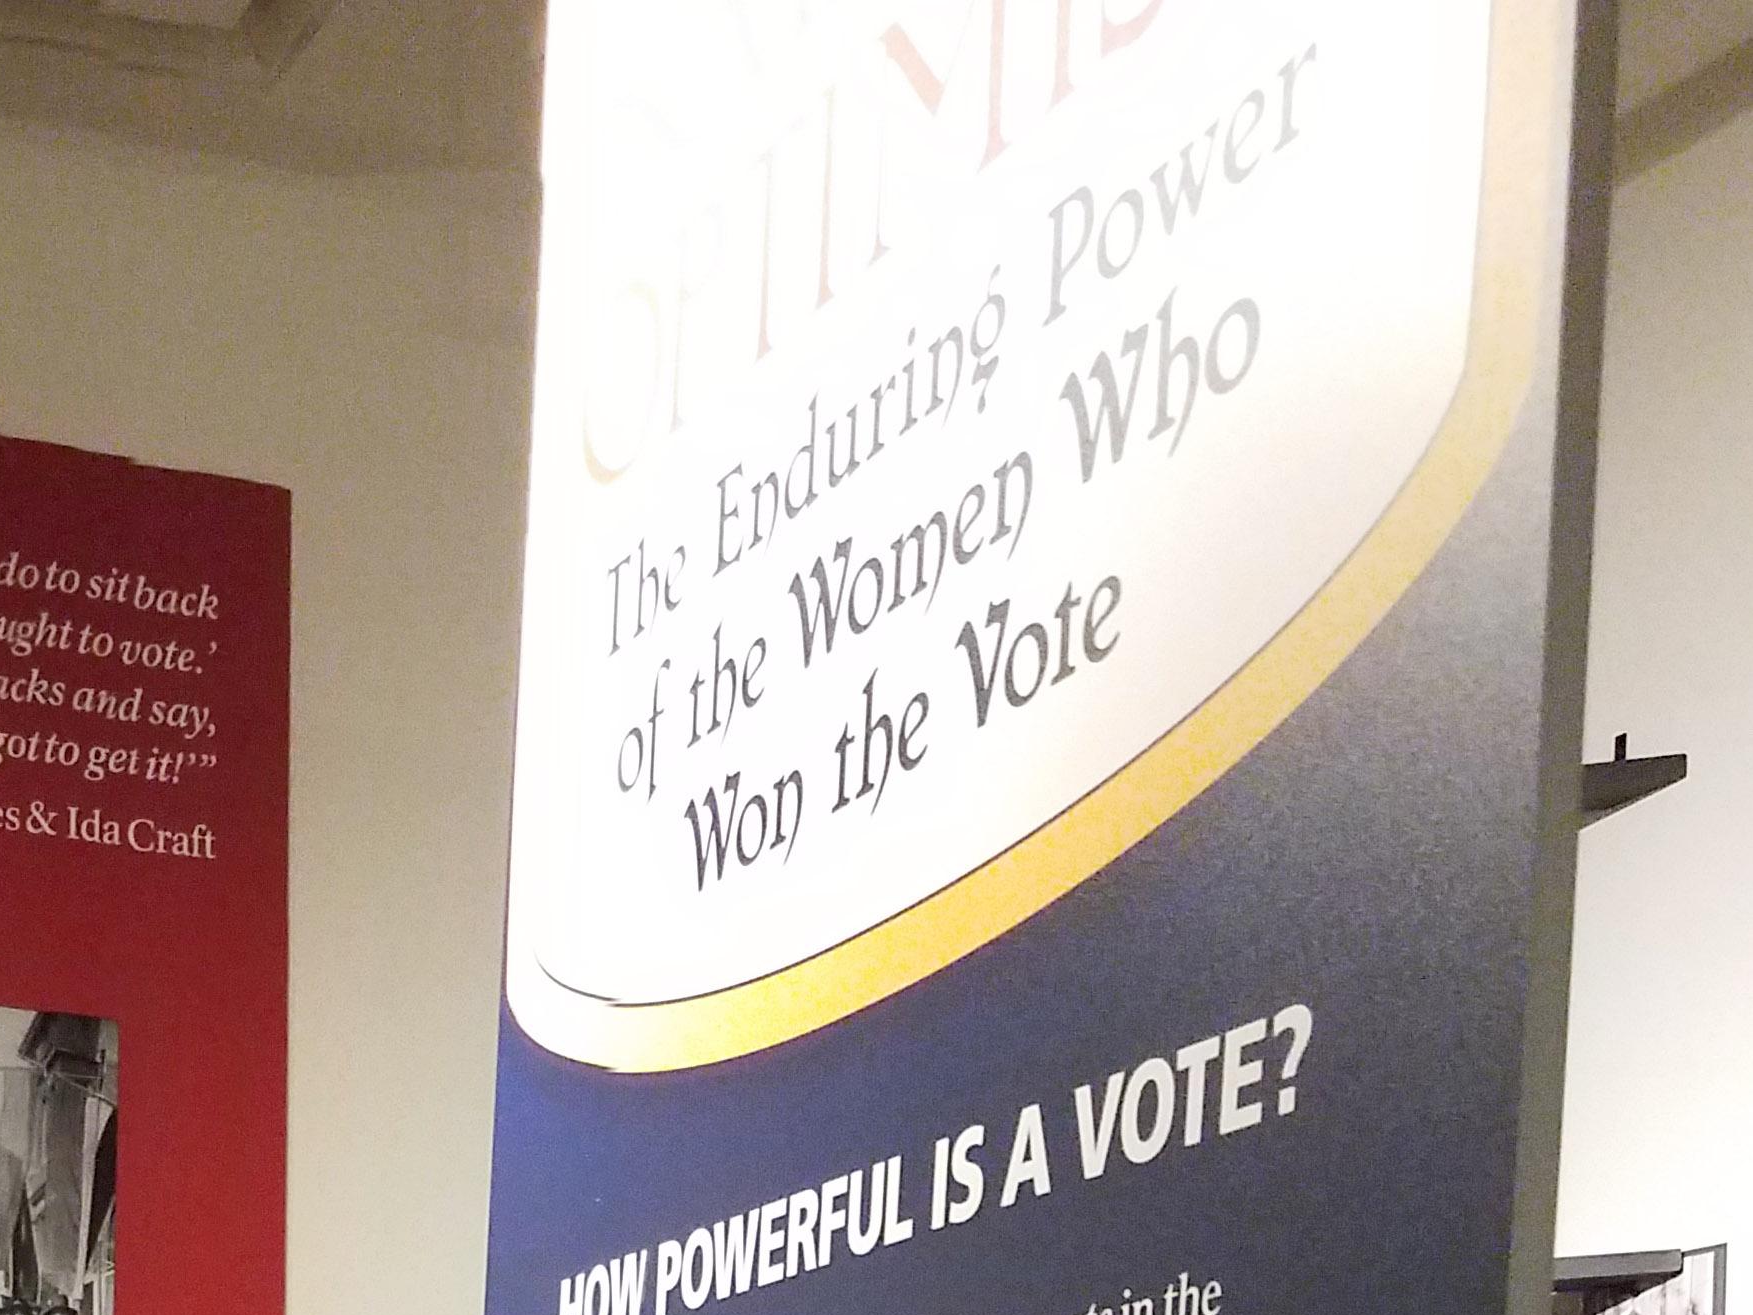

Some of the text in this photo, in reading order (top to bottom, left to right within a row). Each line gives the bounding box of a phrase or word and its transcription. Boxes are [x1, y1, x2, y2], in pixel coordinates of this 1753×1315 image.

[606, 43, 1318, 657] The Enduring Power
[617, 285, 1261, 802] of the Women Who
[24, 801, 58, 836] &
[66, 805, 121, 845] Ida
[126, 817, 216, 859] Craft
[43, 732, 80, 766] to
[82, 745, 139, 781] get
[684, 574, 1123, 892] Won the Vote
[929, 1123, 985, 1230] IS
[999, 1102, 1051, 1208] A
[1073, 1003, 1313, 1180] VOTE?
